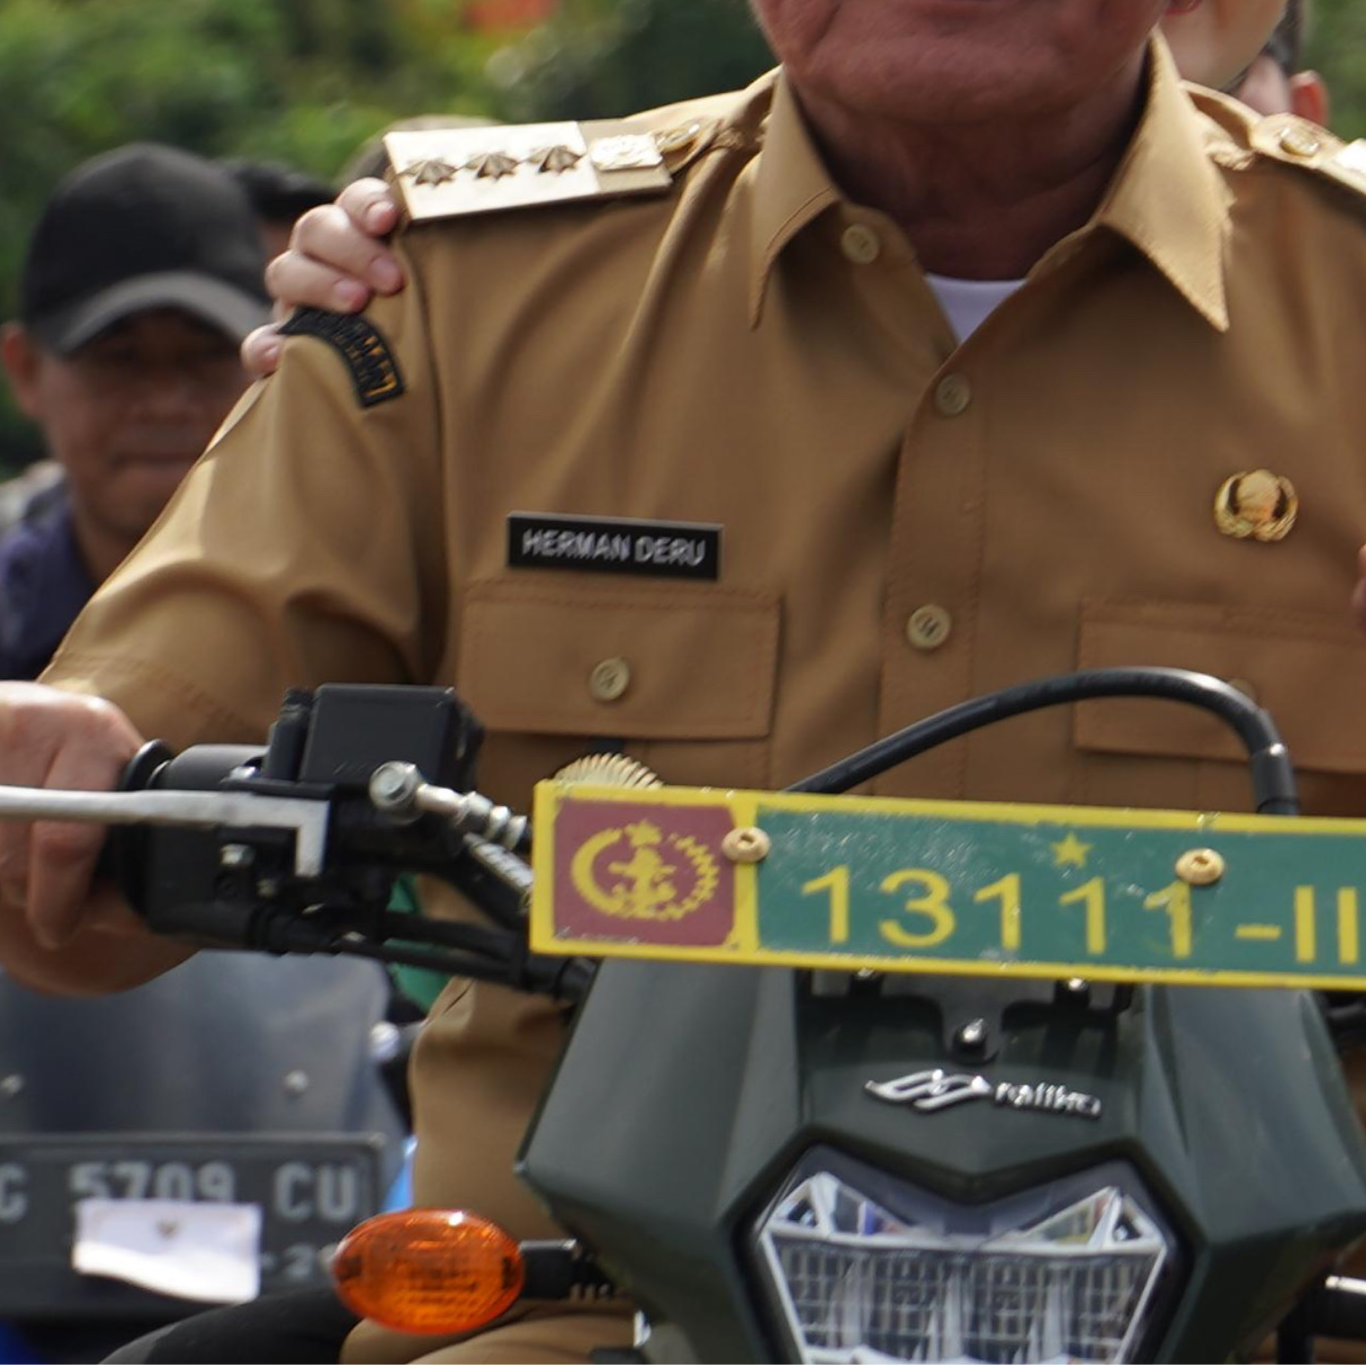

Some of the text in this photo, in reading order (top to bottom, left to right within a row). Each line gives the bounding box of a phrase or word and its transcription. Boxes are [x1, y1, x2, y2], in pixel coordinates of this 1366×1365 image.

[522, 528, 706, 567] HERMAN DERU
[274, 1163, 358, 1220] CU
